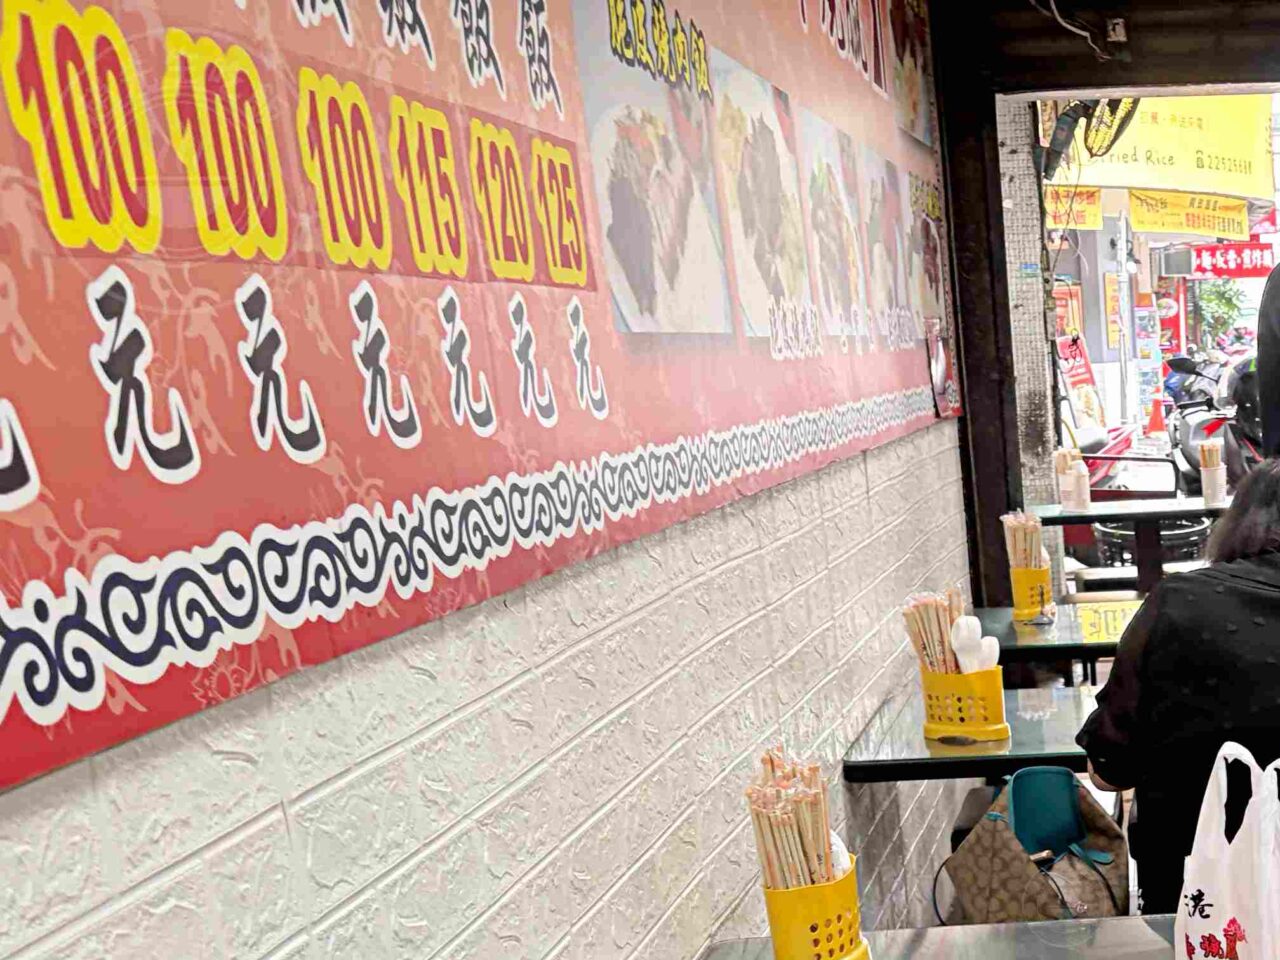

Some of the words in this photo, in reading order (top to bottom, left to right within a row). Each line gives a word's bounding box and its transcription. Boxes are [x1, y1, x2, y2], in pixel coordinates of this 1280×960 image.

[0, 0, 163, 254] 100
[86, 265, 201, 485] 元
[163, 28, 288, 262] 100
[235, 273, 326, 463] 元
[298, 67, 391, 270] 100
[349, 280, 422, 449] 元
[391, 95, 469, 277] 115
[437, 286, 498, 437] 元
[469, 118, 534, 282] 120
[508, 291, 557, 427] 元
[532, 138, 588, 286] 125
[567, 296, 609, 419] 元
[1145, 149, 1176, 166] Rice
